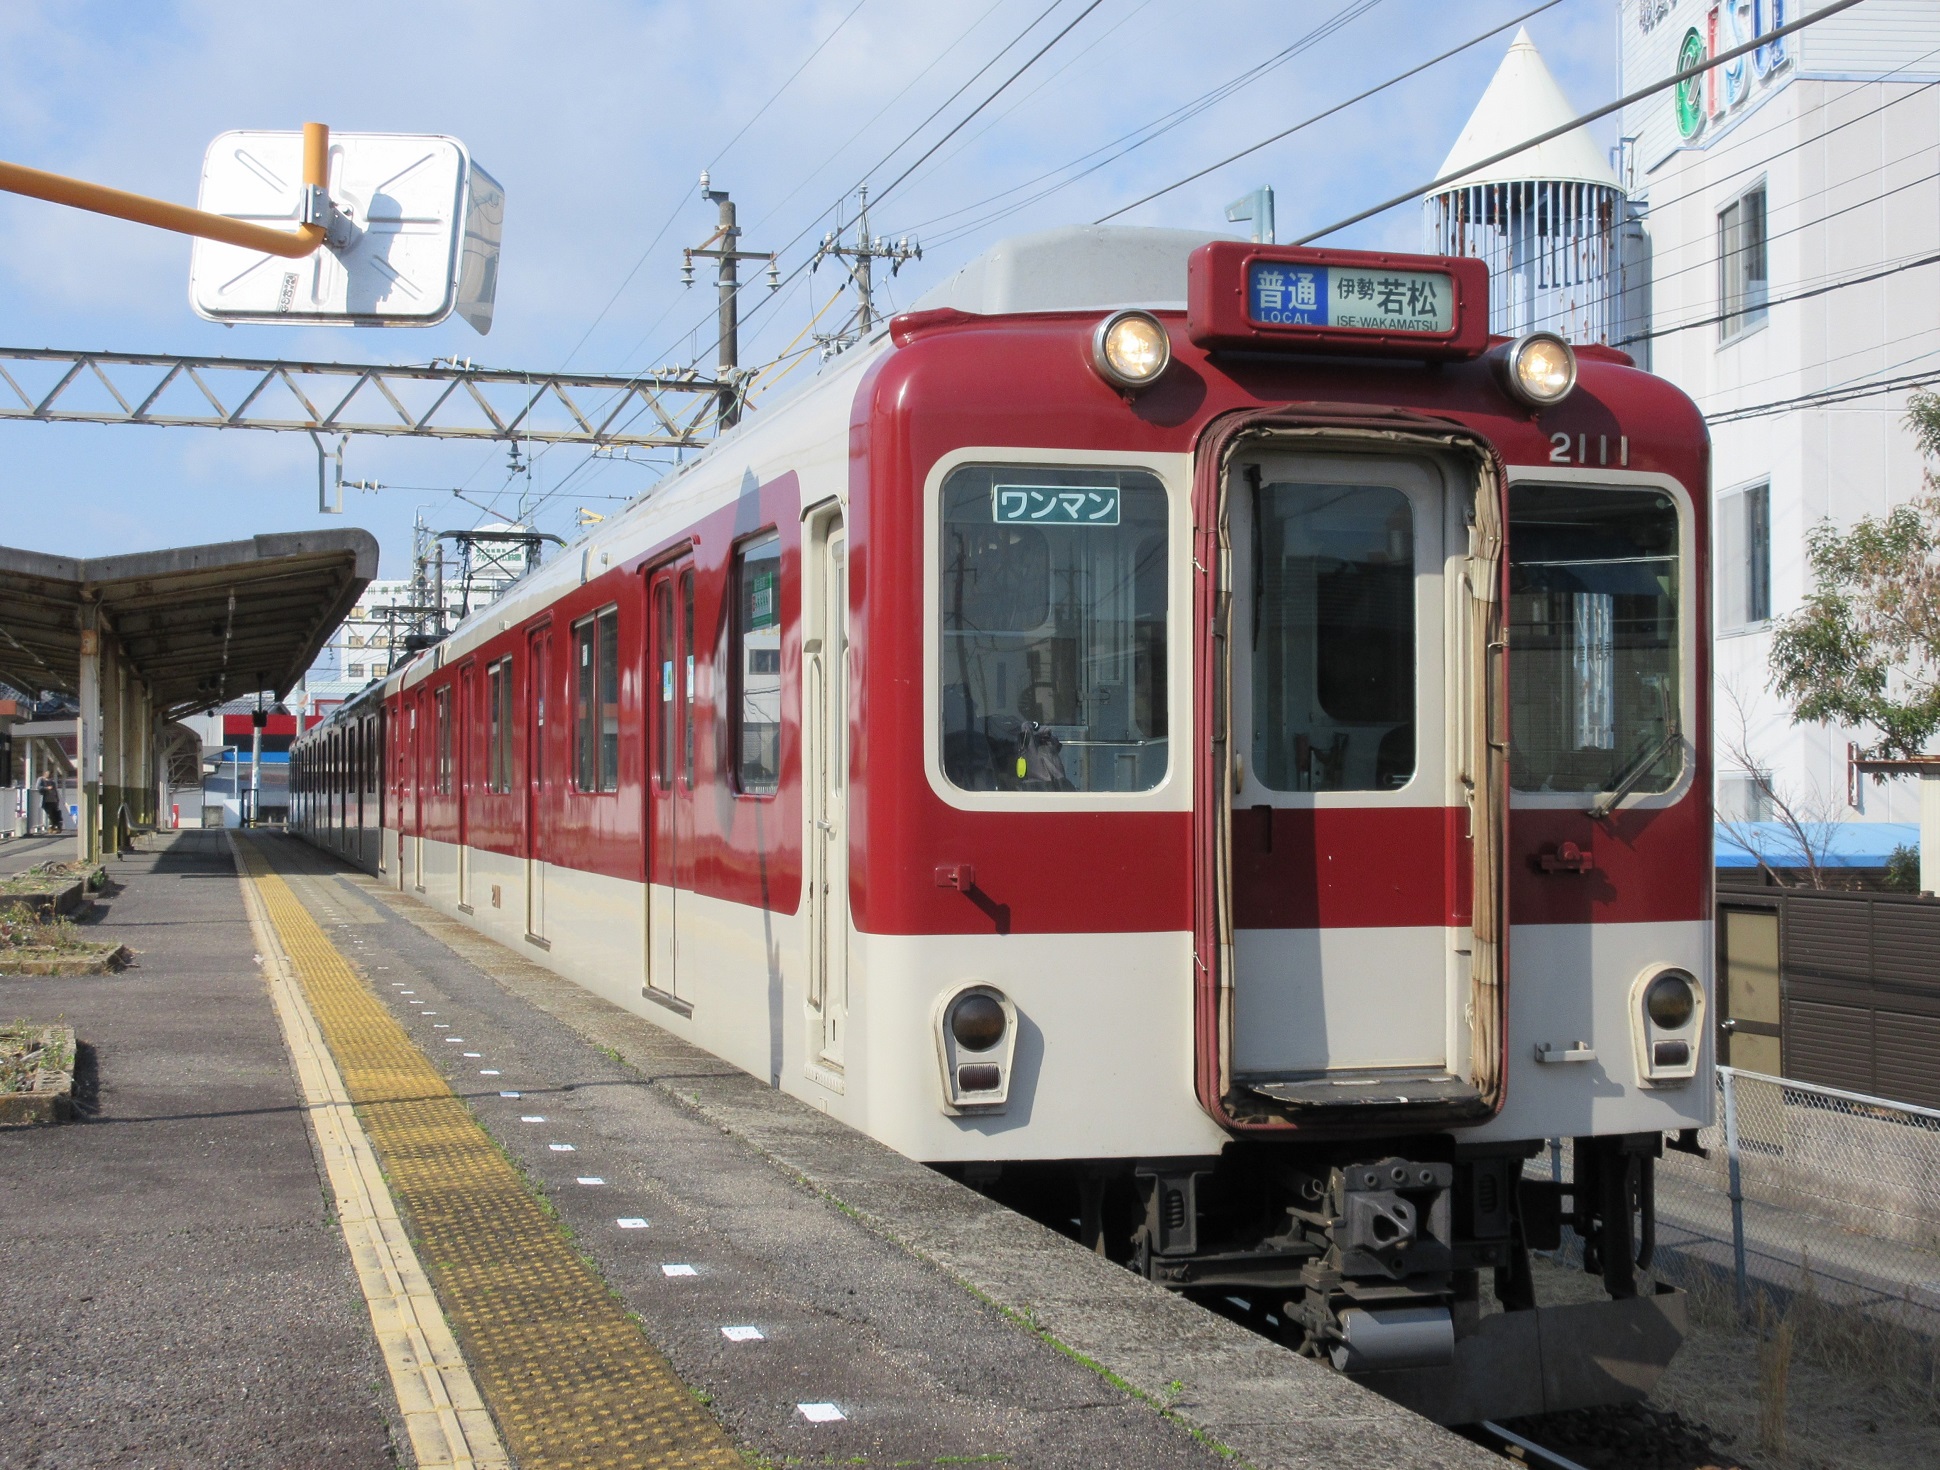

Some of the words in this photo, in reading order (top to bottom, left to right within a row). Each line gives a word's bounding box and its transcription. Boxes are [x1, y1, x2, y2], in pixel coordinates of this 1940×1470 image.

[1256, 270, 1317, 311] 普通
[1337, 277, 1438, 318] 伊勢若松
[1261, 311, 1312, 325] LOCAL
[1336, 315, 1439, 332] ISE-WAKAMATSU
[1549, 431, 1628, 466] 2111
[1001, 491, 1115, 520] ワンマン
